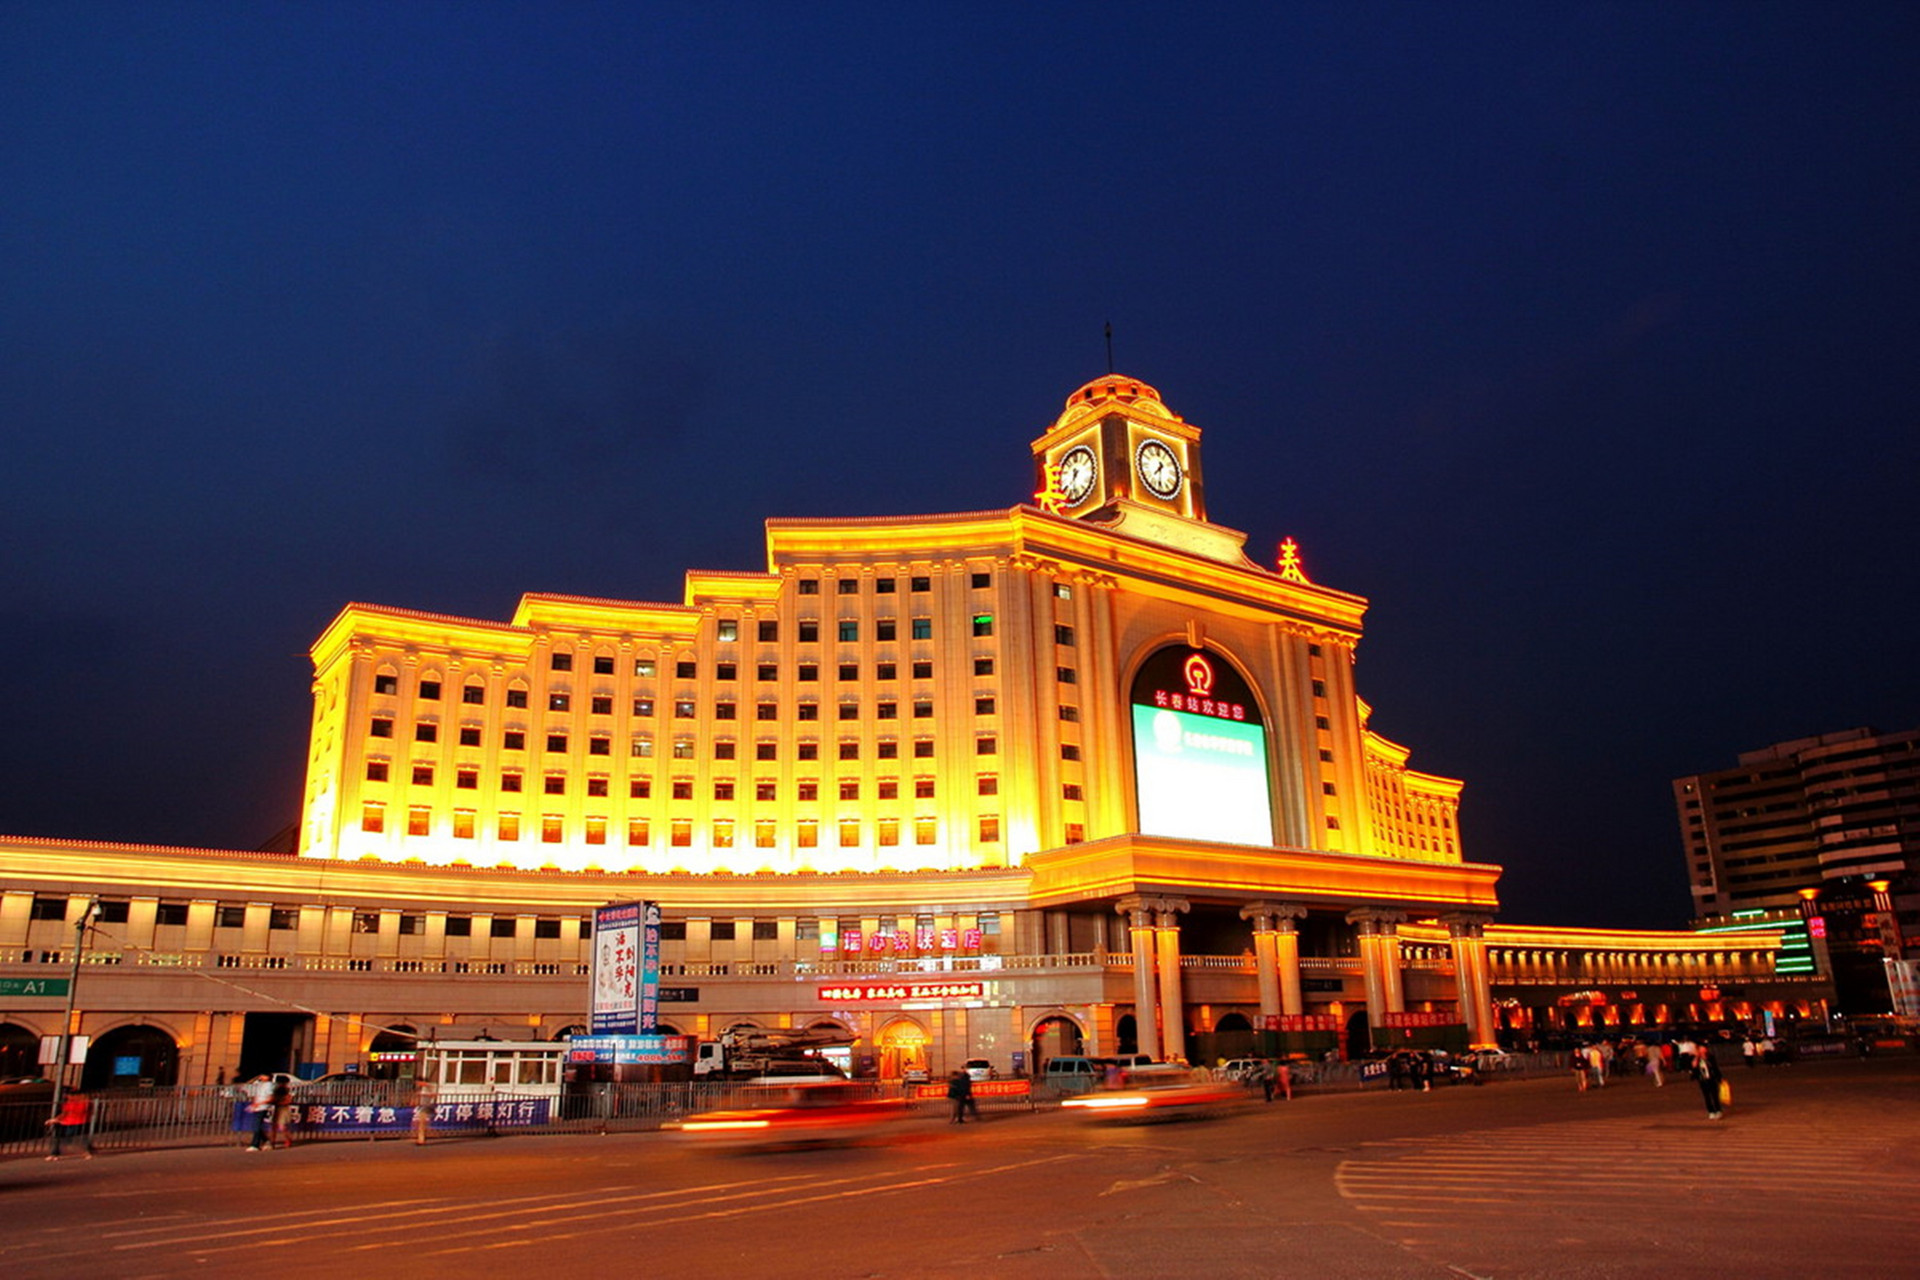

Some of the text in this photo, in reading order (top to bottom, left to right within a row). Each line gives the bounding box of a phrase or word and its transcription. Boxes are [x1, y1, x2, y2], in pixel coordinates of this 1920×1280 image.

[1155, 690, 1245, 721] 长春站欢迎您
[22, 980, 46, 994] A1
